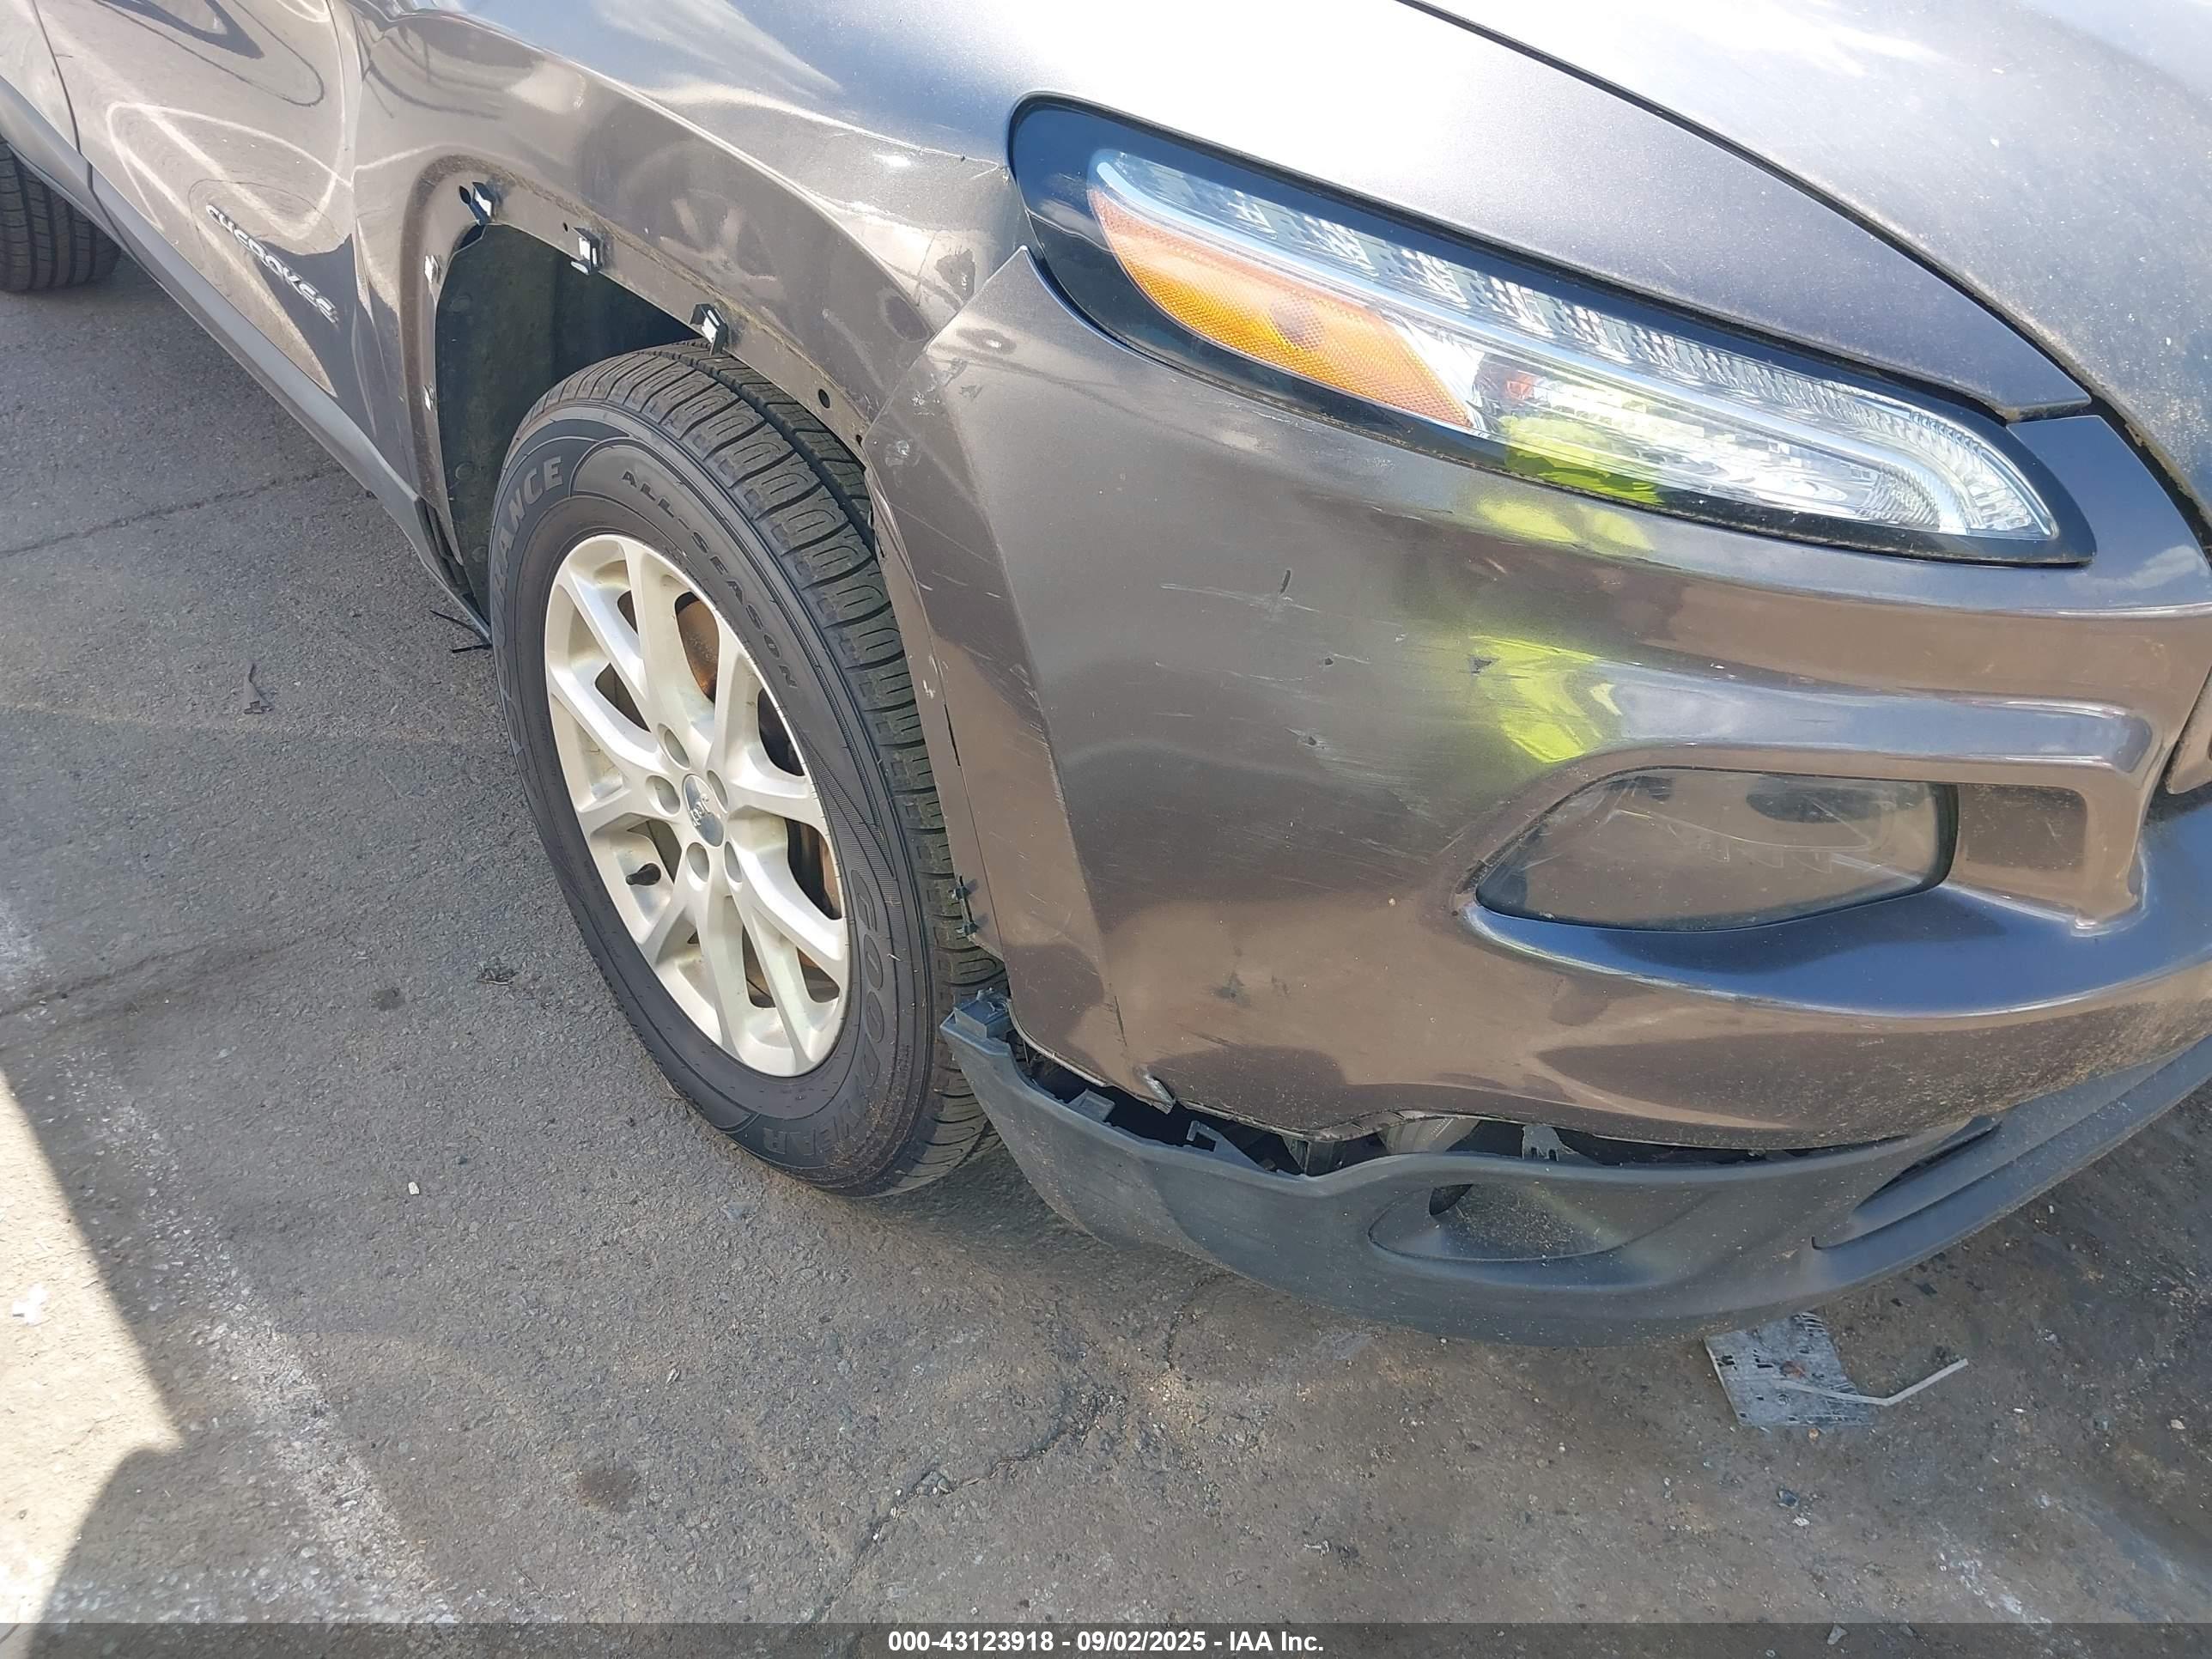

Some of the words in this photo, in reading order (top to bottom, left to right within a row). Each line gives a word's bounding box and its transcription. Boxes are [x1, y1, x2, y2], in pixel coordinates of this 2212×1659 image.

[206, 204, 340, 324] CHEROKEE
[619, 470, 799, 689] ALL-SEASON
[762, 869, 885, 1156] GOODYEAR
